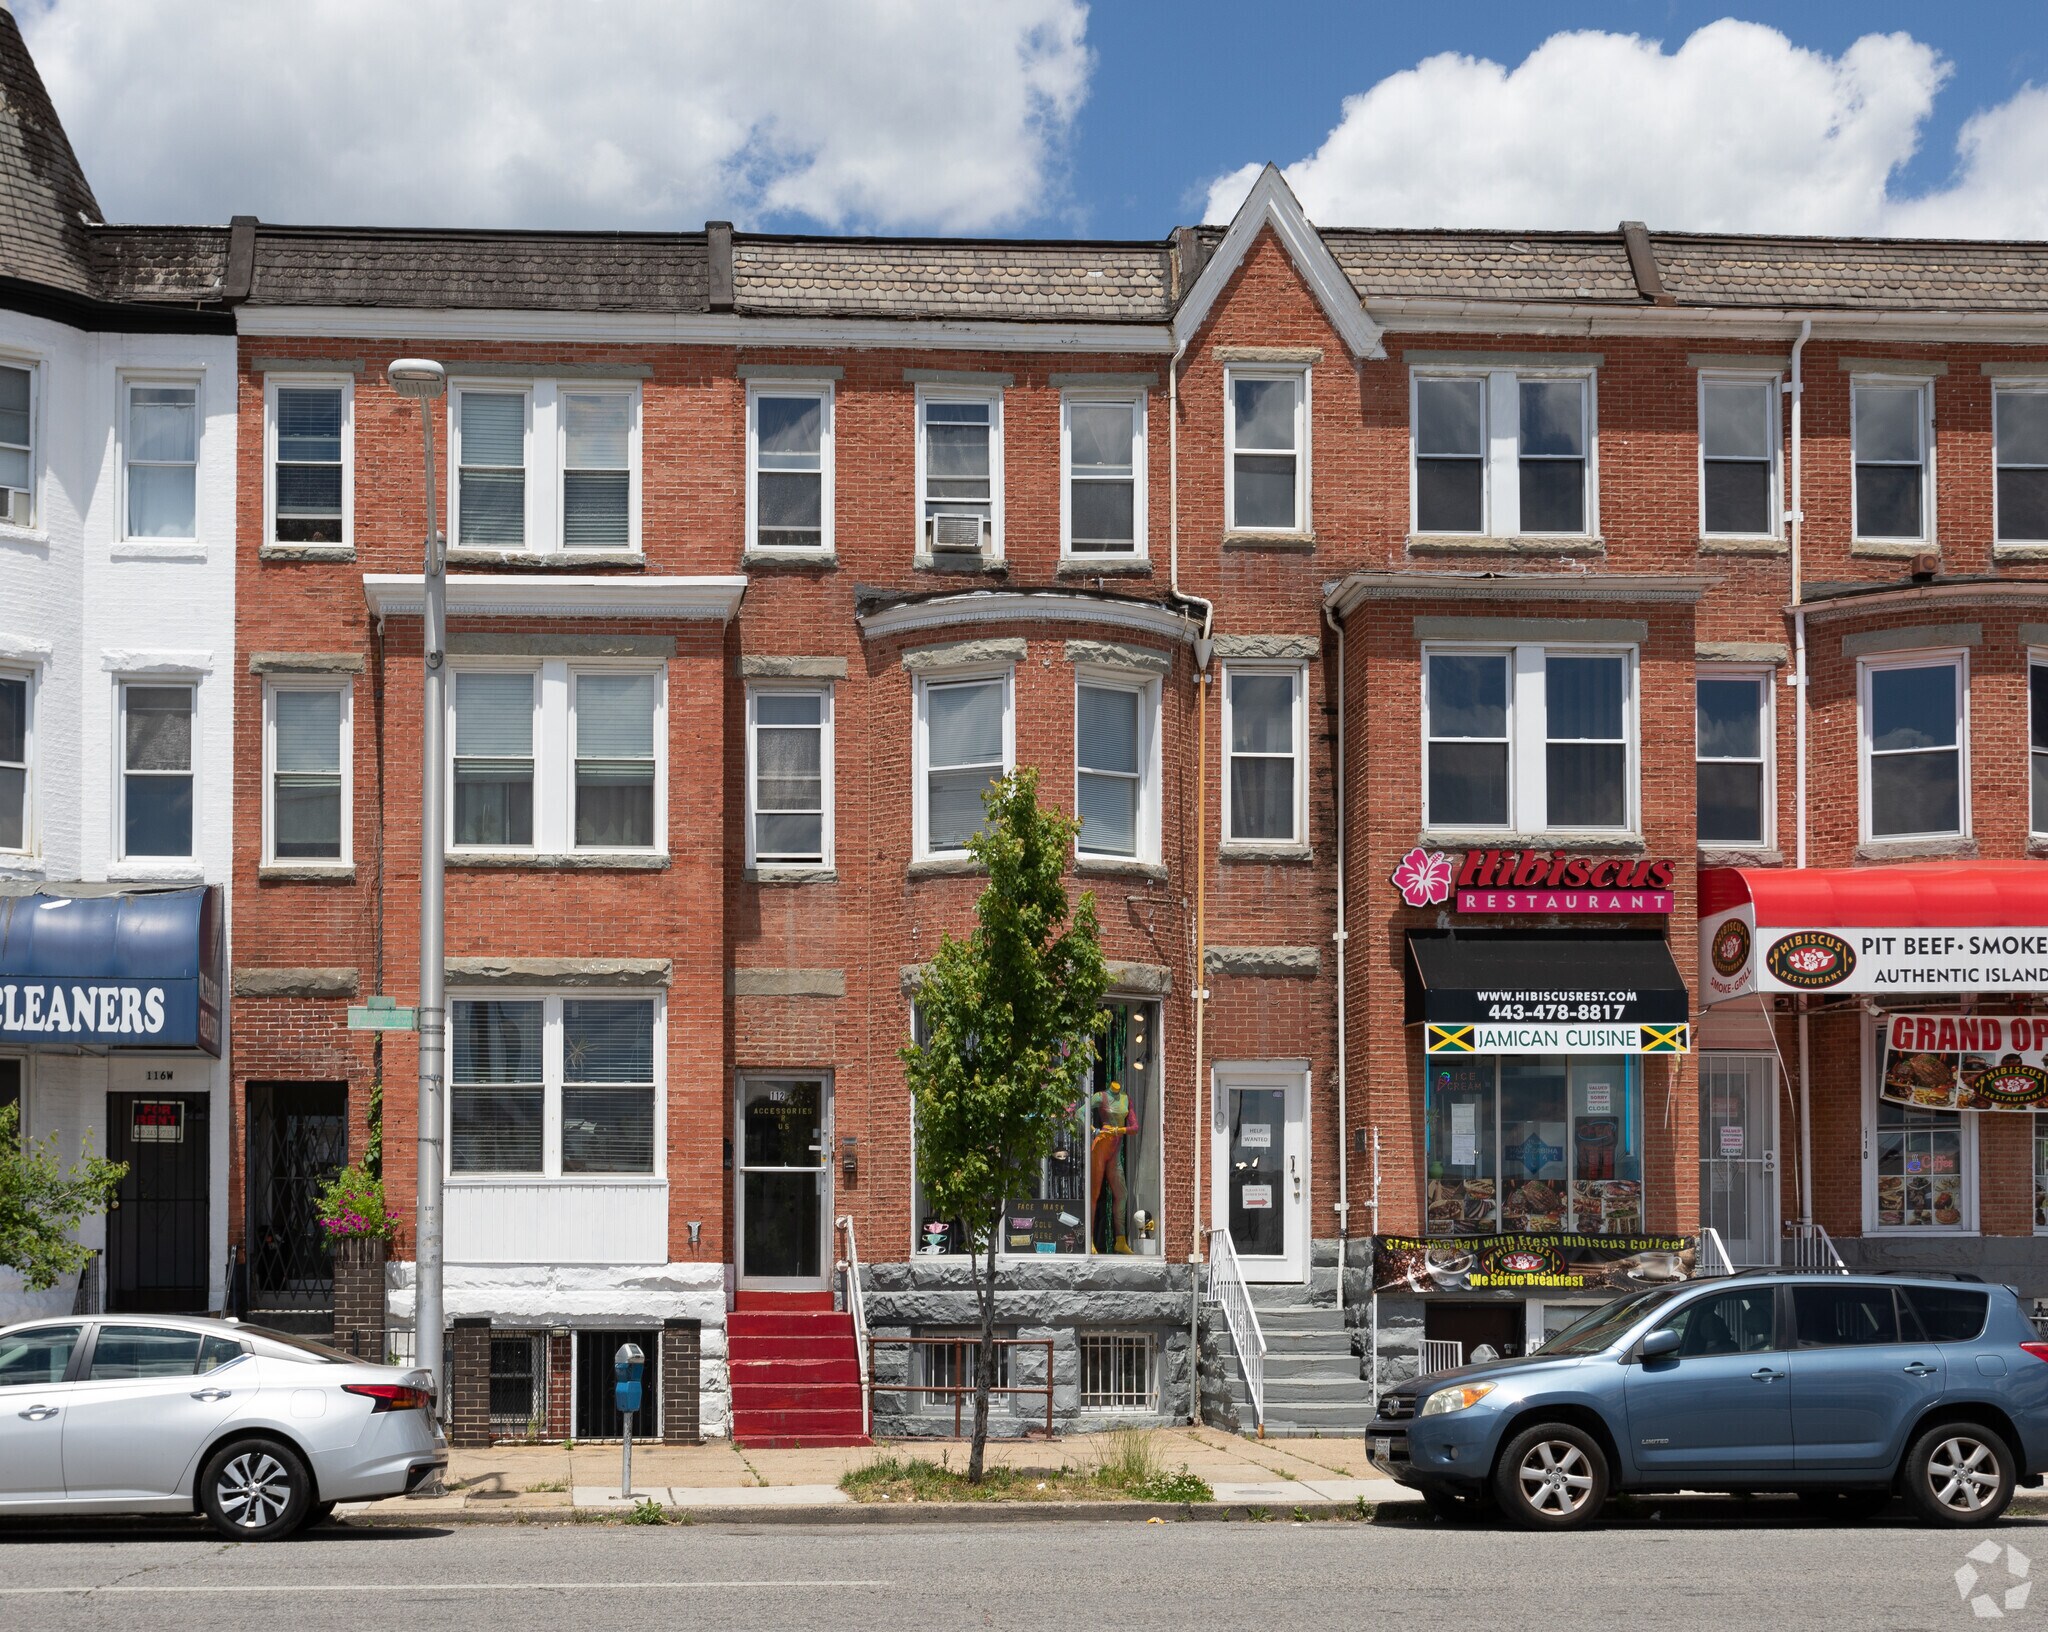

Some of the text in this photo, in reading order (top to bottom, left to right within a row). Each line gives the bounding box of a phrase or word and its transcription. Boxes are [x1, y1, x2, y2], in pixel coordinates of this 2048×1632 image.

[1457, 849, 1676, 888] Hibiscus
[1466, 894, 1665, 908] RESTAURANT
[1780, 934, 1843, 955] HIBISCUS
[1862, 937, 1896, 955] PIT
[1905, 937, 1955, 955] BEEF
[1780, 969, 1843, 985] RESTAURANT
[1874, 968, 2048, 983] AUTHENTIC ISLAND
[1477, 991, 1637, 1002] WWW.HIBISCUSREST.COM
[0, 985, 165, 1033] LEANERS
[1489, 1004, 1625, 1020] 443-478-8817
[1479, 1029, 1636, 1047] JAMICAN CUISINE
[1892, 1016, 2002, 1051] GRAND
[147, 1071, 174, 1080] 116W
[1455, 1072, 1476, 1081] ICE
[1986, 1066, 2043, 1081] HIBISCUS
[770, 1091, 785, 1100] 112
[1983, 1090, 2044, 1102] RESTAURANT
[143, 1104, 171, 1115] FOR
[136, 1115, 176, 1126] RENT
[1921, 1154, 1953, 1172] Coffee
[1017, 1203, 1065, 1212] FACE MASK
[1386, 1235, 1686, 1251] Start The Day with Fresh Hibiscus Coffee!
[1469, 1273, 1584, 1287] We Serve Breakfast
